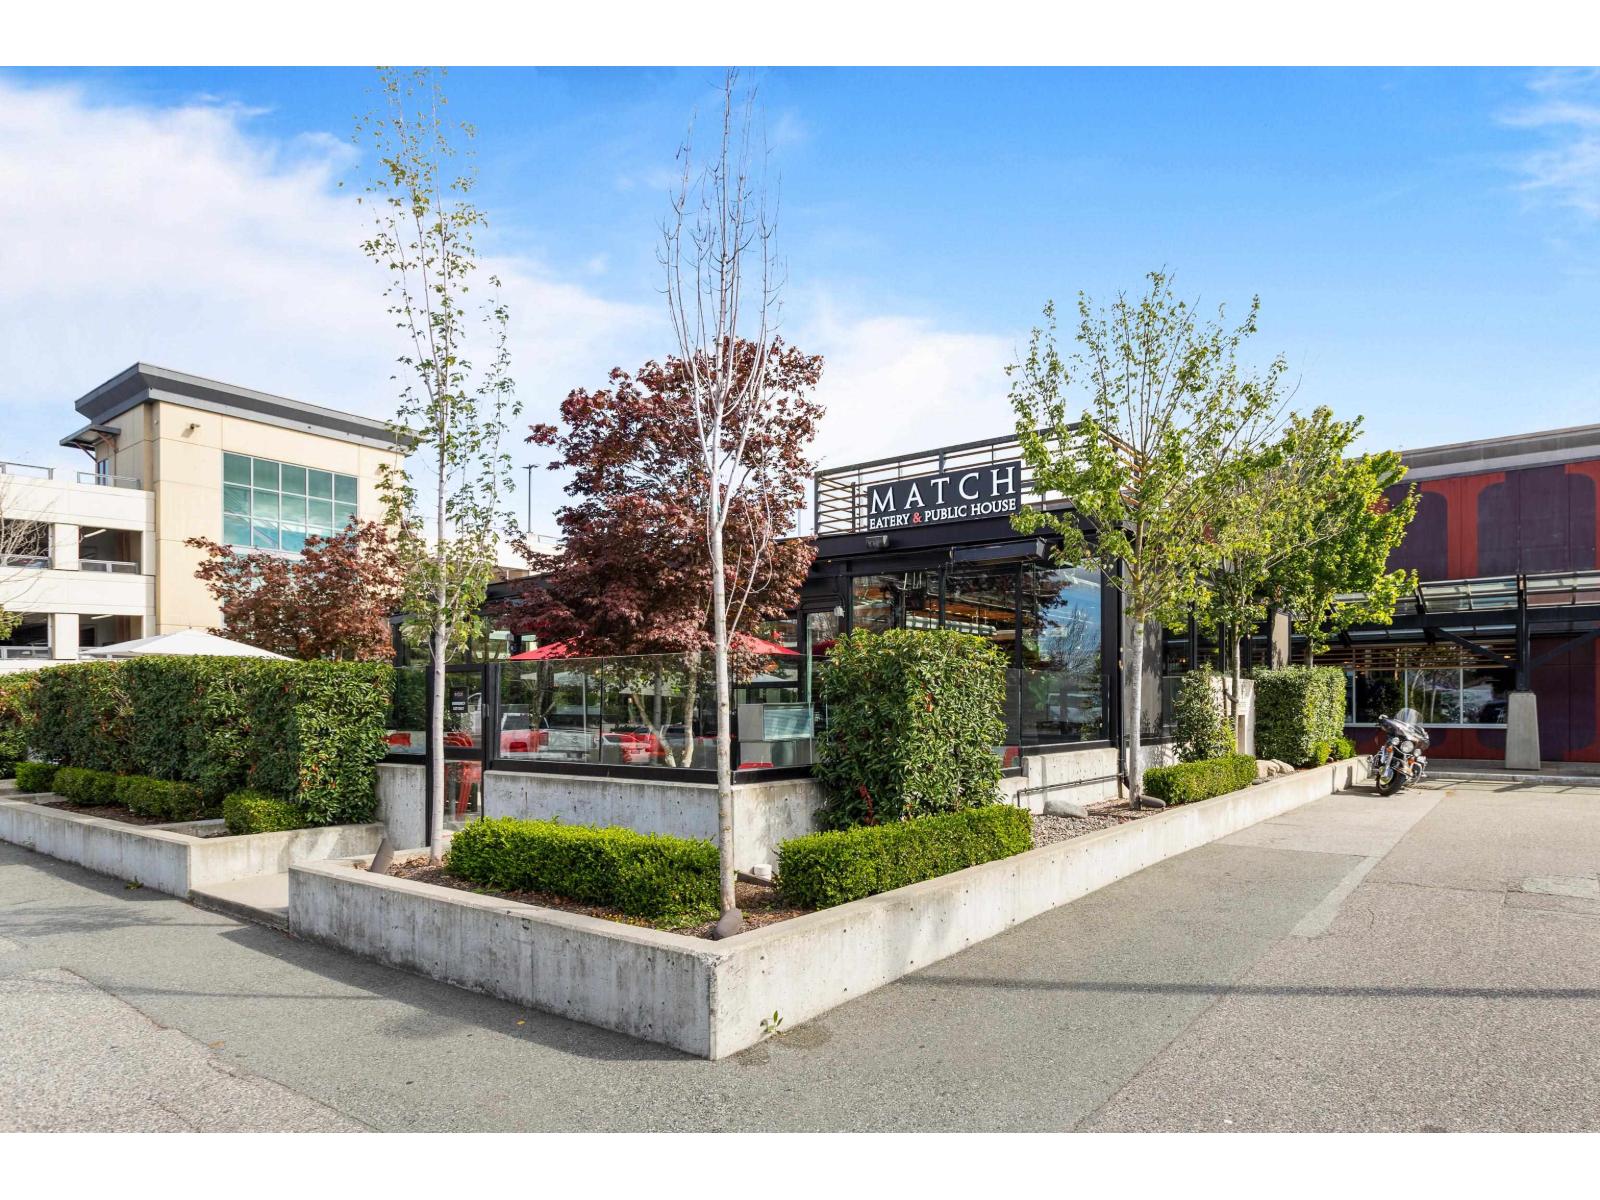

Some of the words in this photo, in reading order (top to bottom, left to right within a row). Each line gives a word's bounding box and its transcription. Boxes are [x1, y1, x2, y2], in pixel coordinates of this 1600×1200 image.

[870, 467, 1016, 514] MATCH
[869, 513, 910, 530] EATERY
[912, 512, 922, 524] &
[924, 505, 967, 522] PUBLIC
[971, 499, 1016, 516] HOUSE
